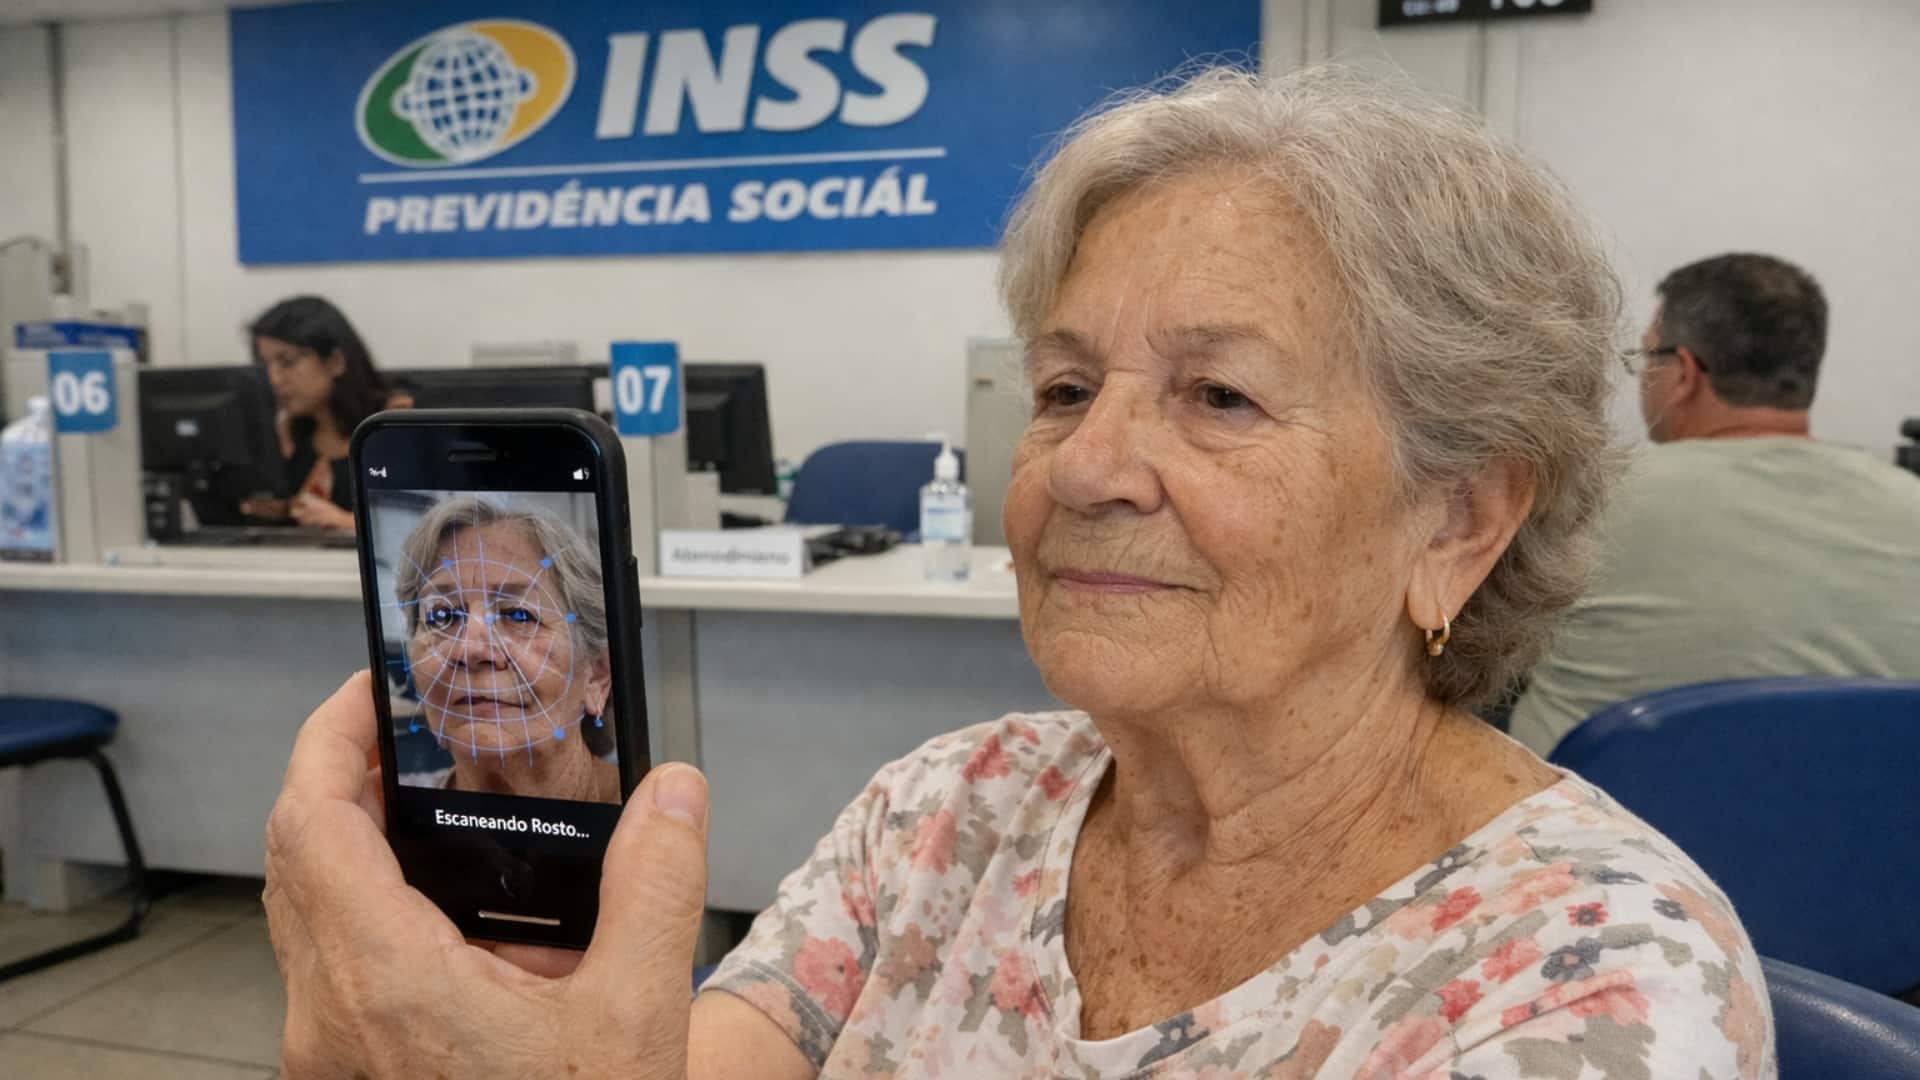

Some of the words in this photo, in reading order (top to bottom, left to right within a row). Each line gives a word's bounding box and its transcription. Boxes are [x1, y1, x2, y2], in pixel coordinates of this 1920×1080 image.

[595, 13, 937, 139] INSS
[728, 166, 937, 222] SOCIÁL
[54, 371, 109, 415] 06
[616, 365, 672, 414] 07
[435, 809, 528, 832] Escaneando
[531, 817, 590, 838] Rosto...
